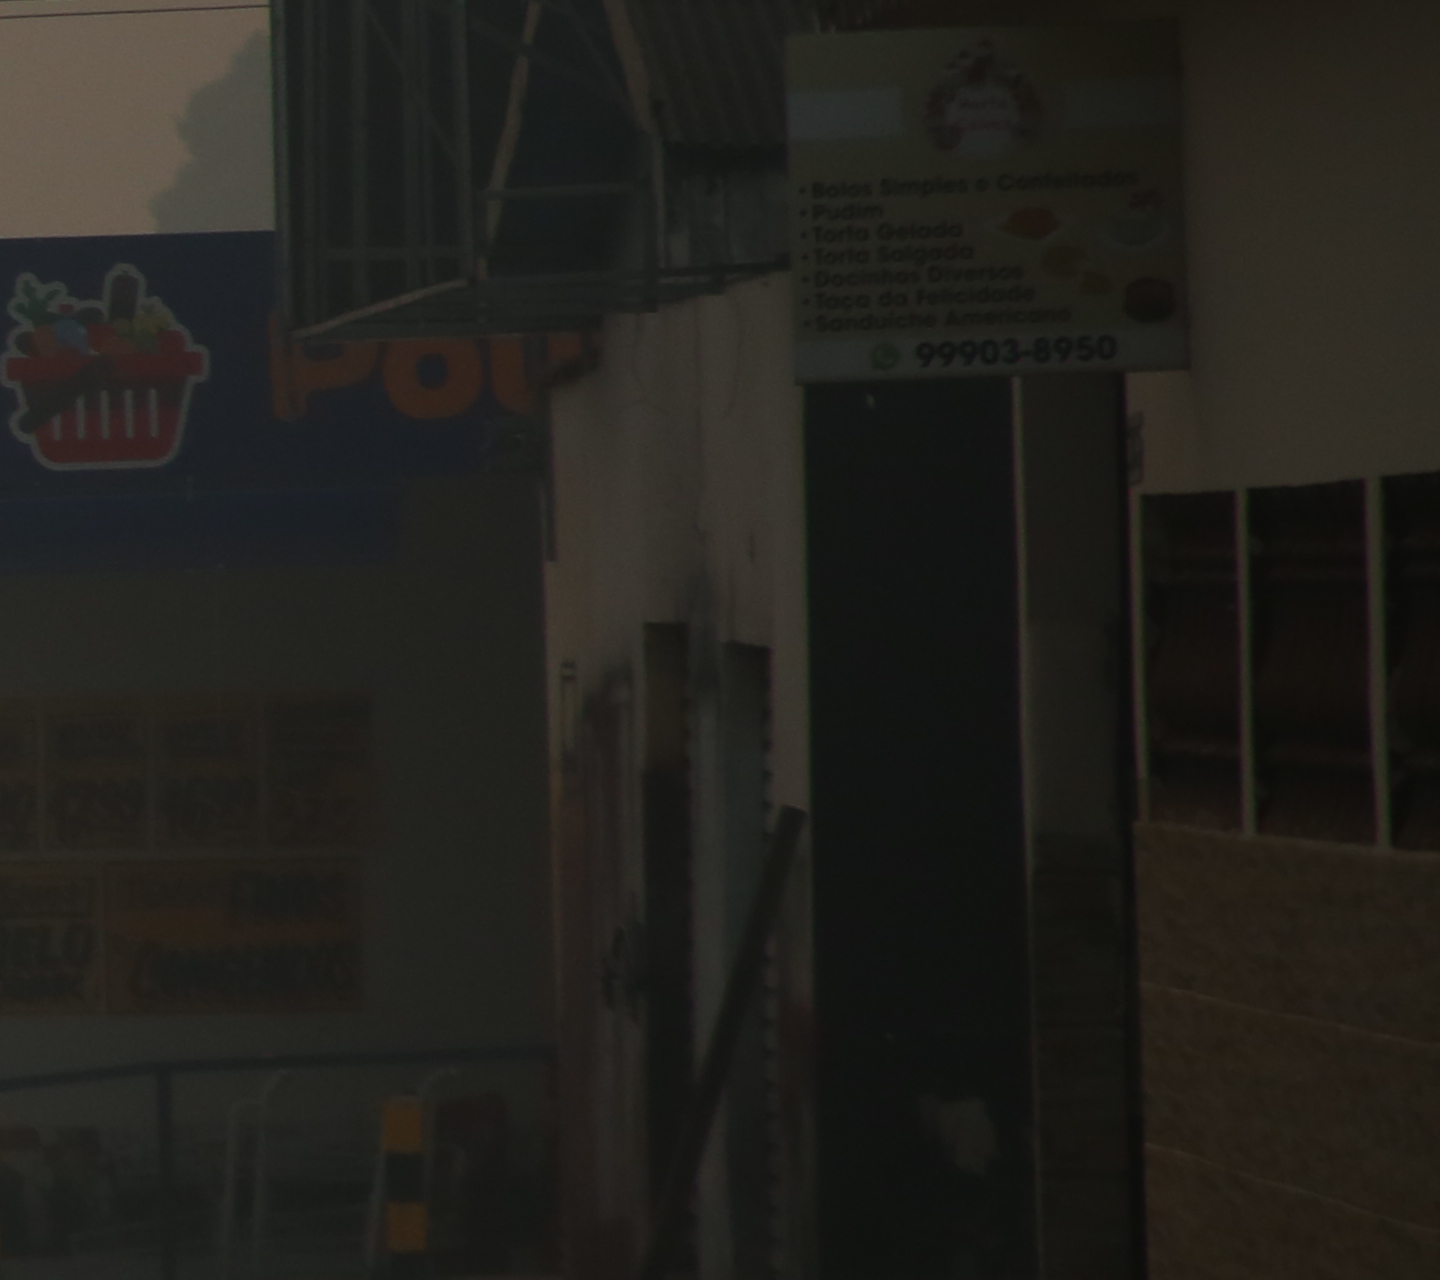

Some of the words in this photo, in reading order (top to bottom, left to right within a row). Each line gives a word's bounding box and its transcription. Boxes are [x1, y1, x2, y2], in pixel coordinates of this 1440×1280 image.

[812, 181, 873, 199] Bolos
[880, 176, 969, 197] Simples
[975, 178, 990, 192] e
[996, 171, 1140, 192] Confeitados
[812, 202, 884, 221] Pudim
[812, 226, 870, 244] Torta
[876, 221, 964, 241] Gelada
[813, 248, 870, 265] Torta
[877, 244, 975, 265] Salgada
[814, 269, 920, 288] Docinhos
[926, 266, 1025, 283] Diversos
[814, 293, 871, 312] Taça
[916, 285, 1035, 304] Felicidade
[944, 307, 1072, 327] Americano
[915, 335, 1117, 369] 99903-8950
